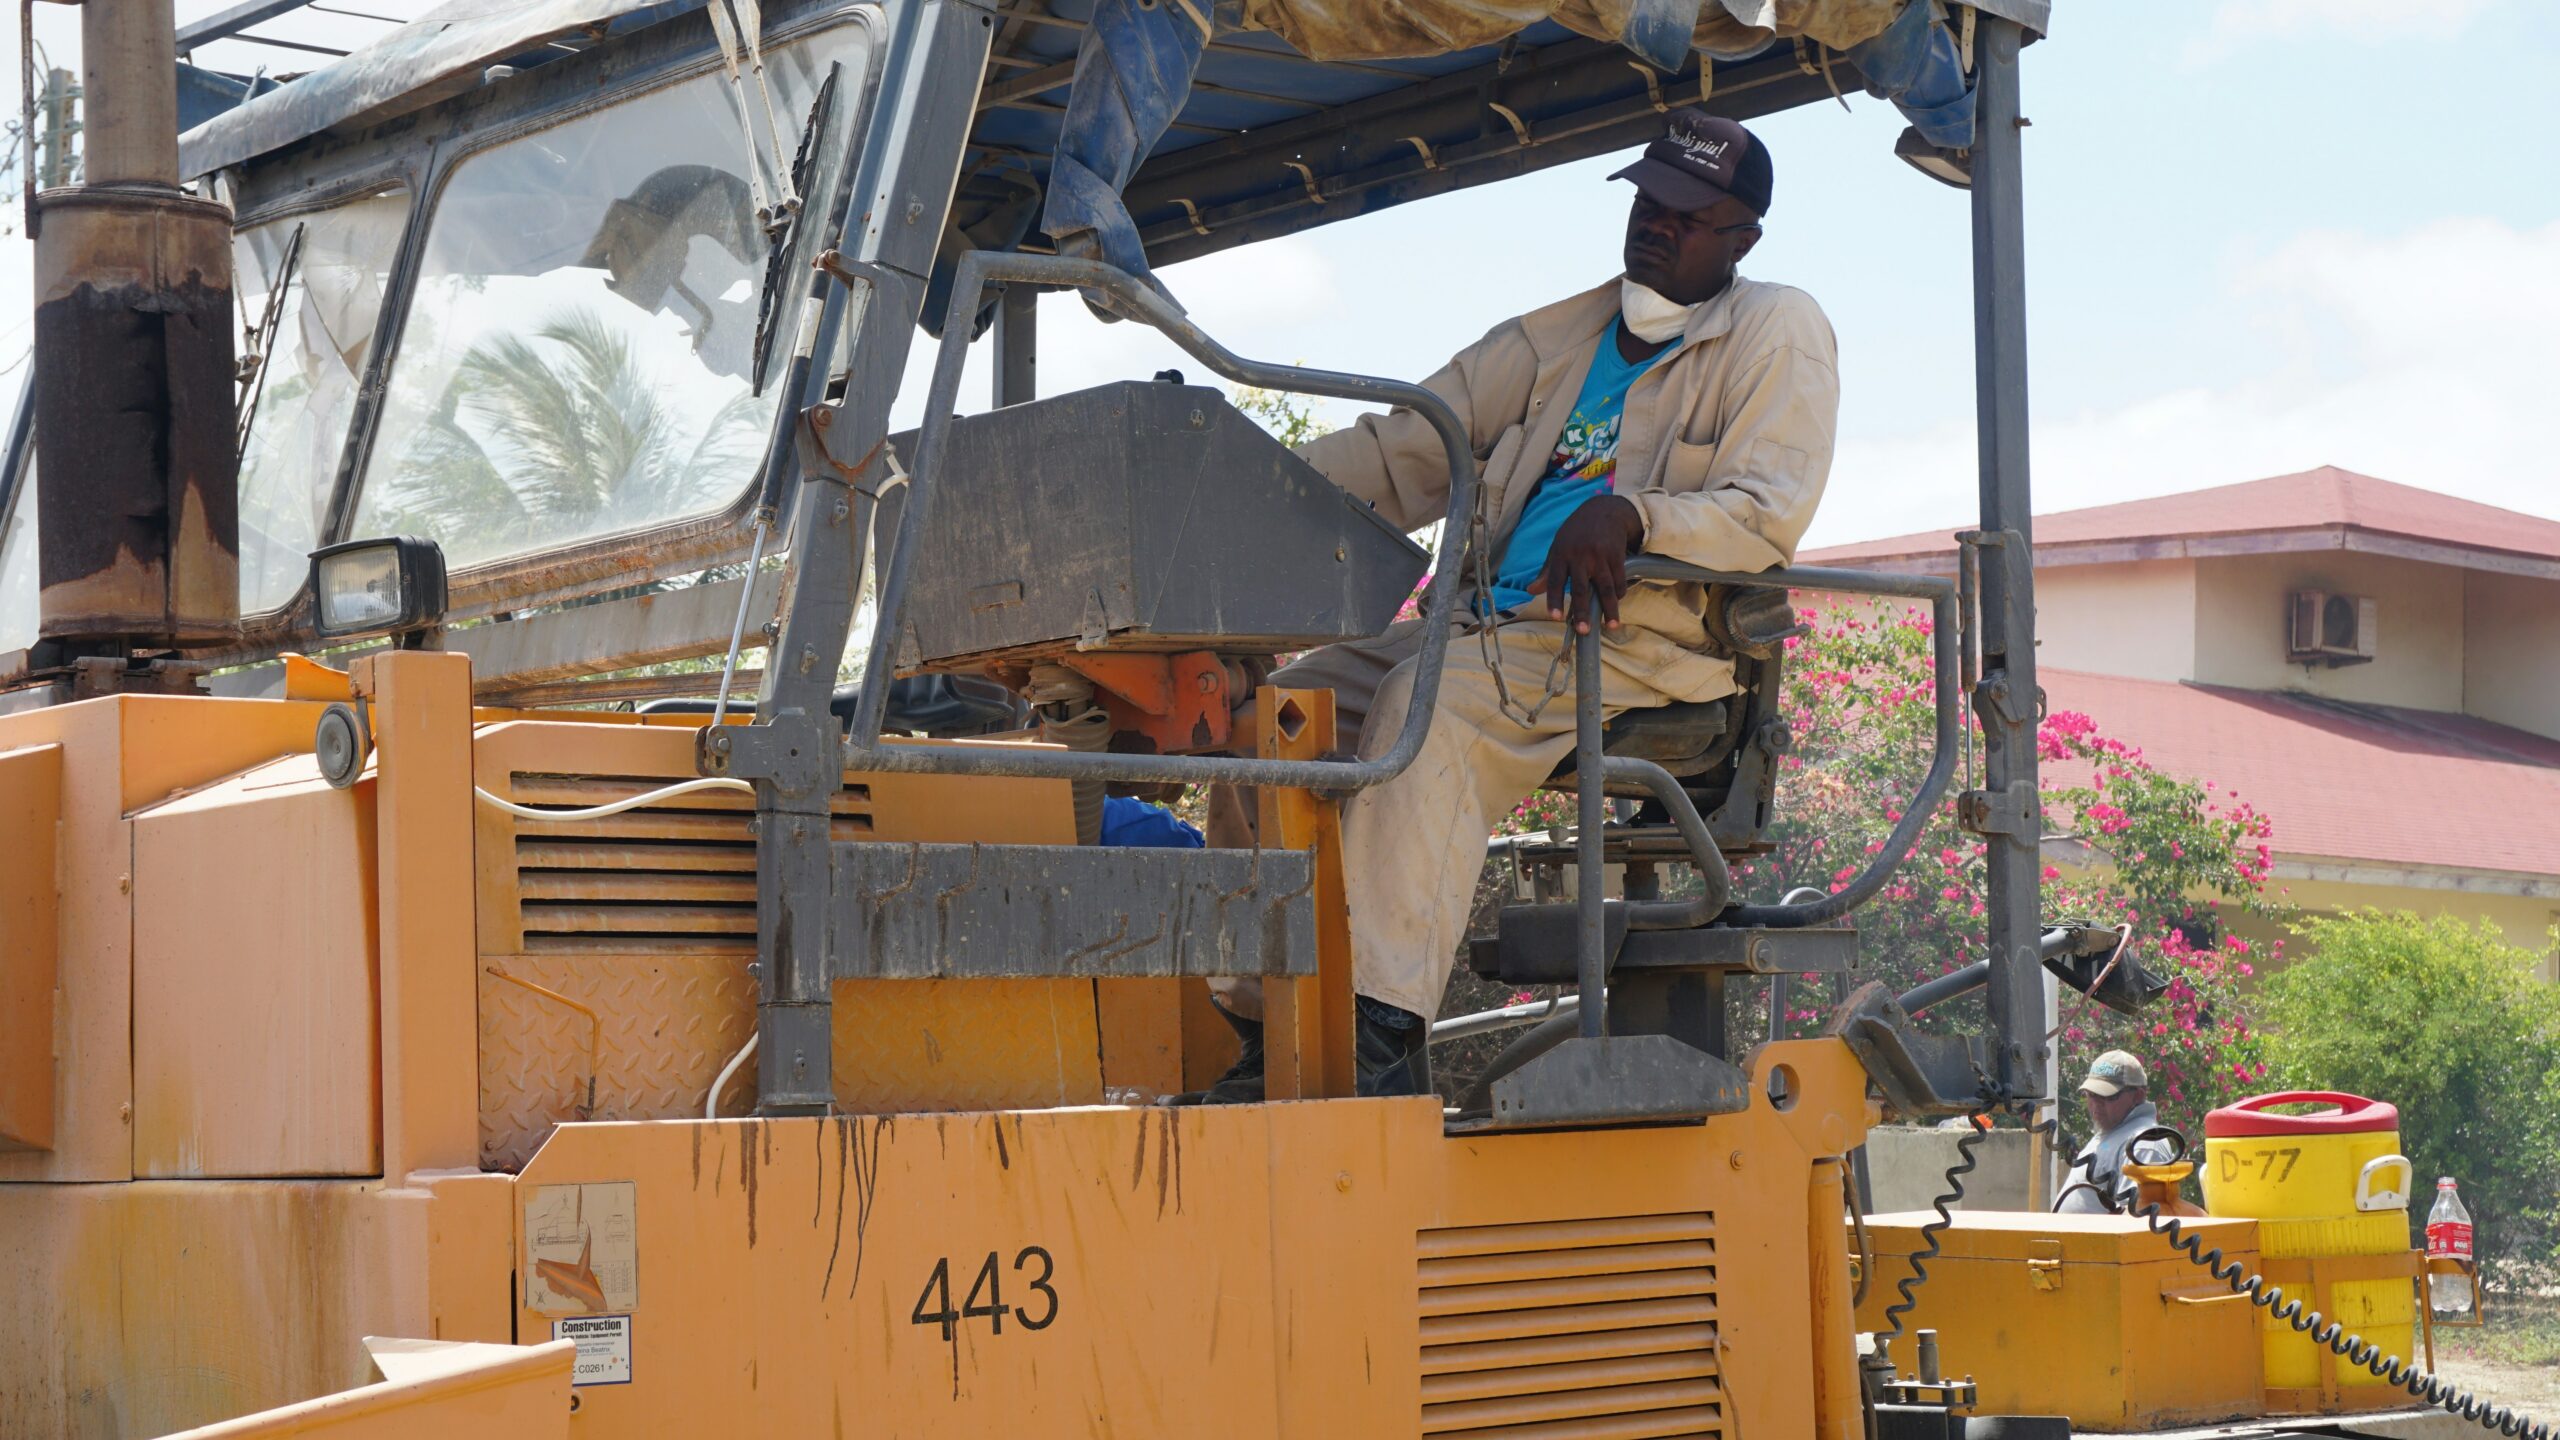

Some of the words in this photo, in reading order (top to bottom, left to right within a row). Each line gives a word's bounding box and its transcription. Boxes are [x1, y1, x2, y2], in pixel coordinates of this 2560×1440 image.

[1567, 428, 1584, 444] K
[2219, 1147, 2302, 1184] D-77
[911, 1245, 1059, 1342] 443
[562, 1319, 621, 1333] Construction
